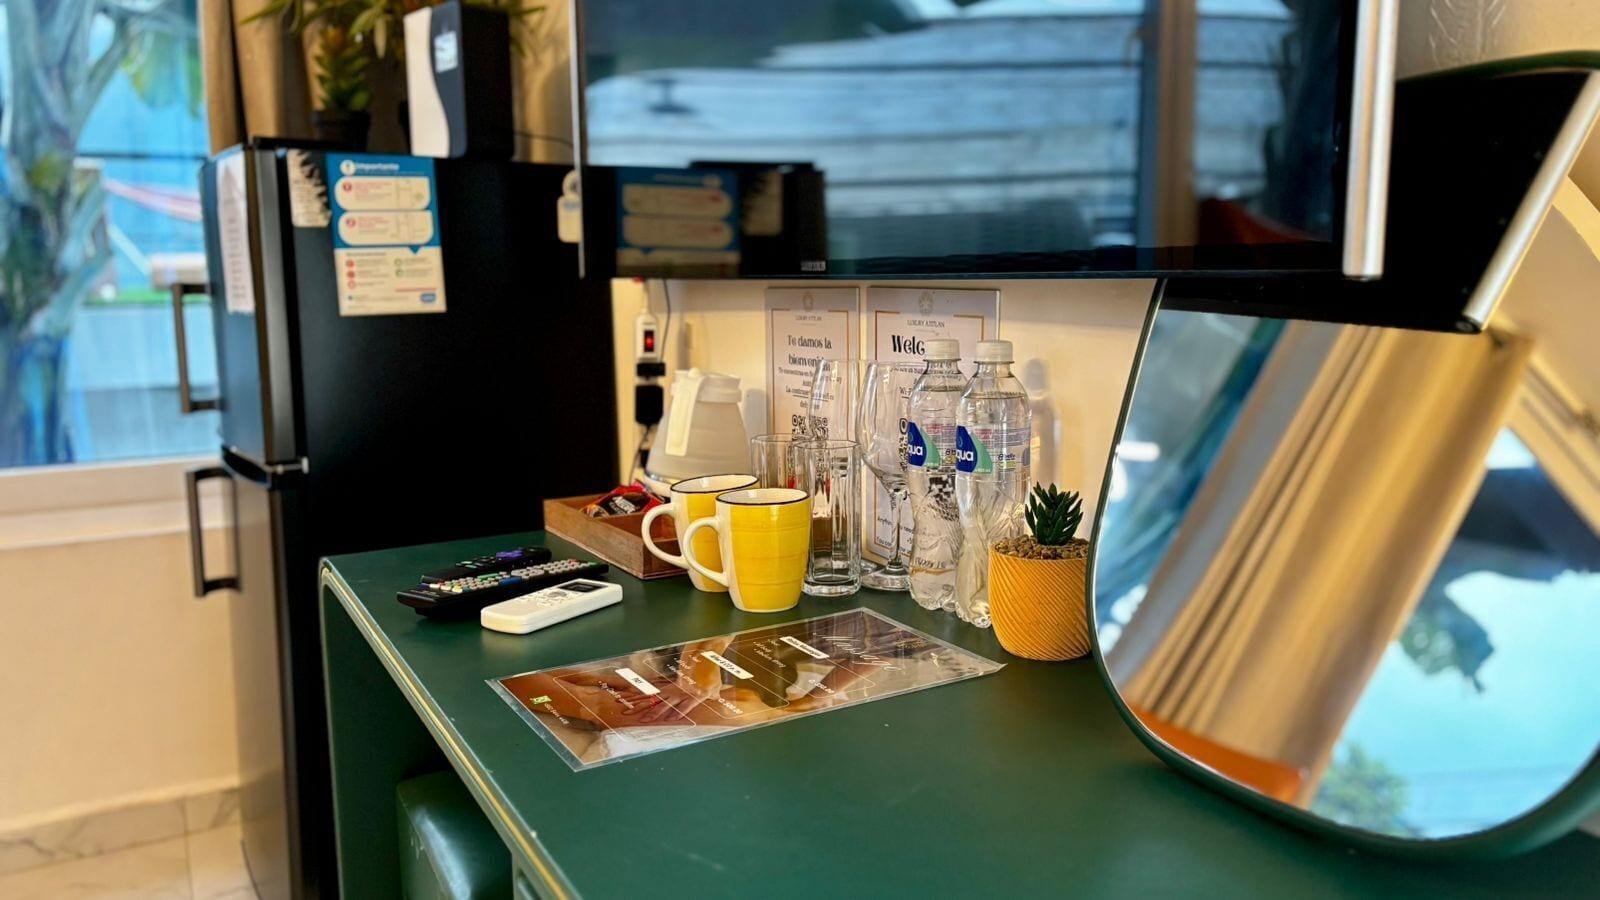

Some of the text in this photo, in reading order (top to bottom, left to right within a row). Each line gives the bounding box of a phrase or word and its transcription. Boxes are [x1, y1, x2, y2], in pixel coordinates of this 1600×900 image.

[787, 335, 832, 349] Te damos la
